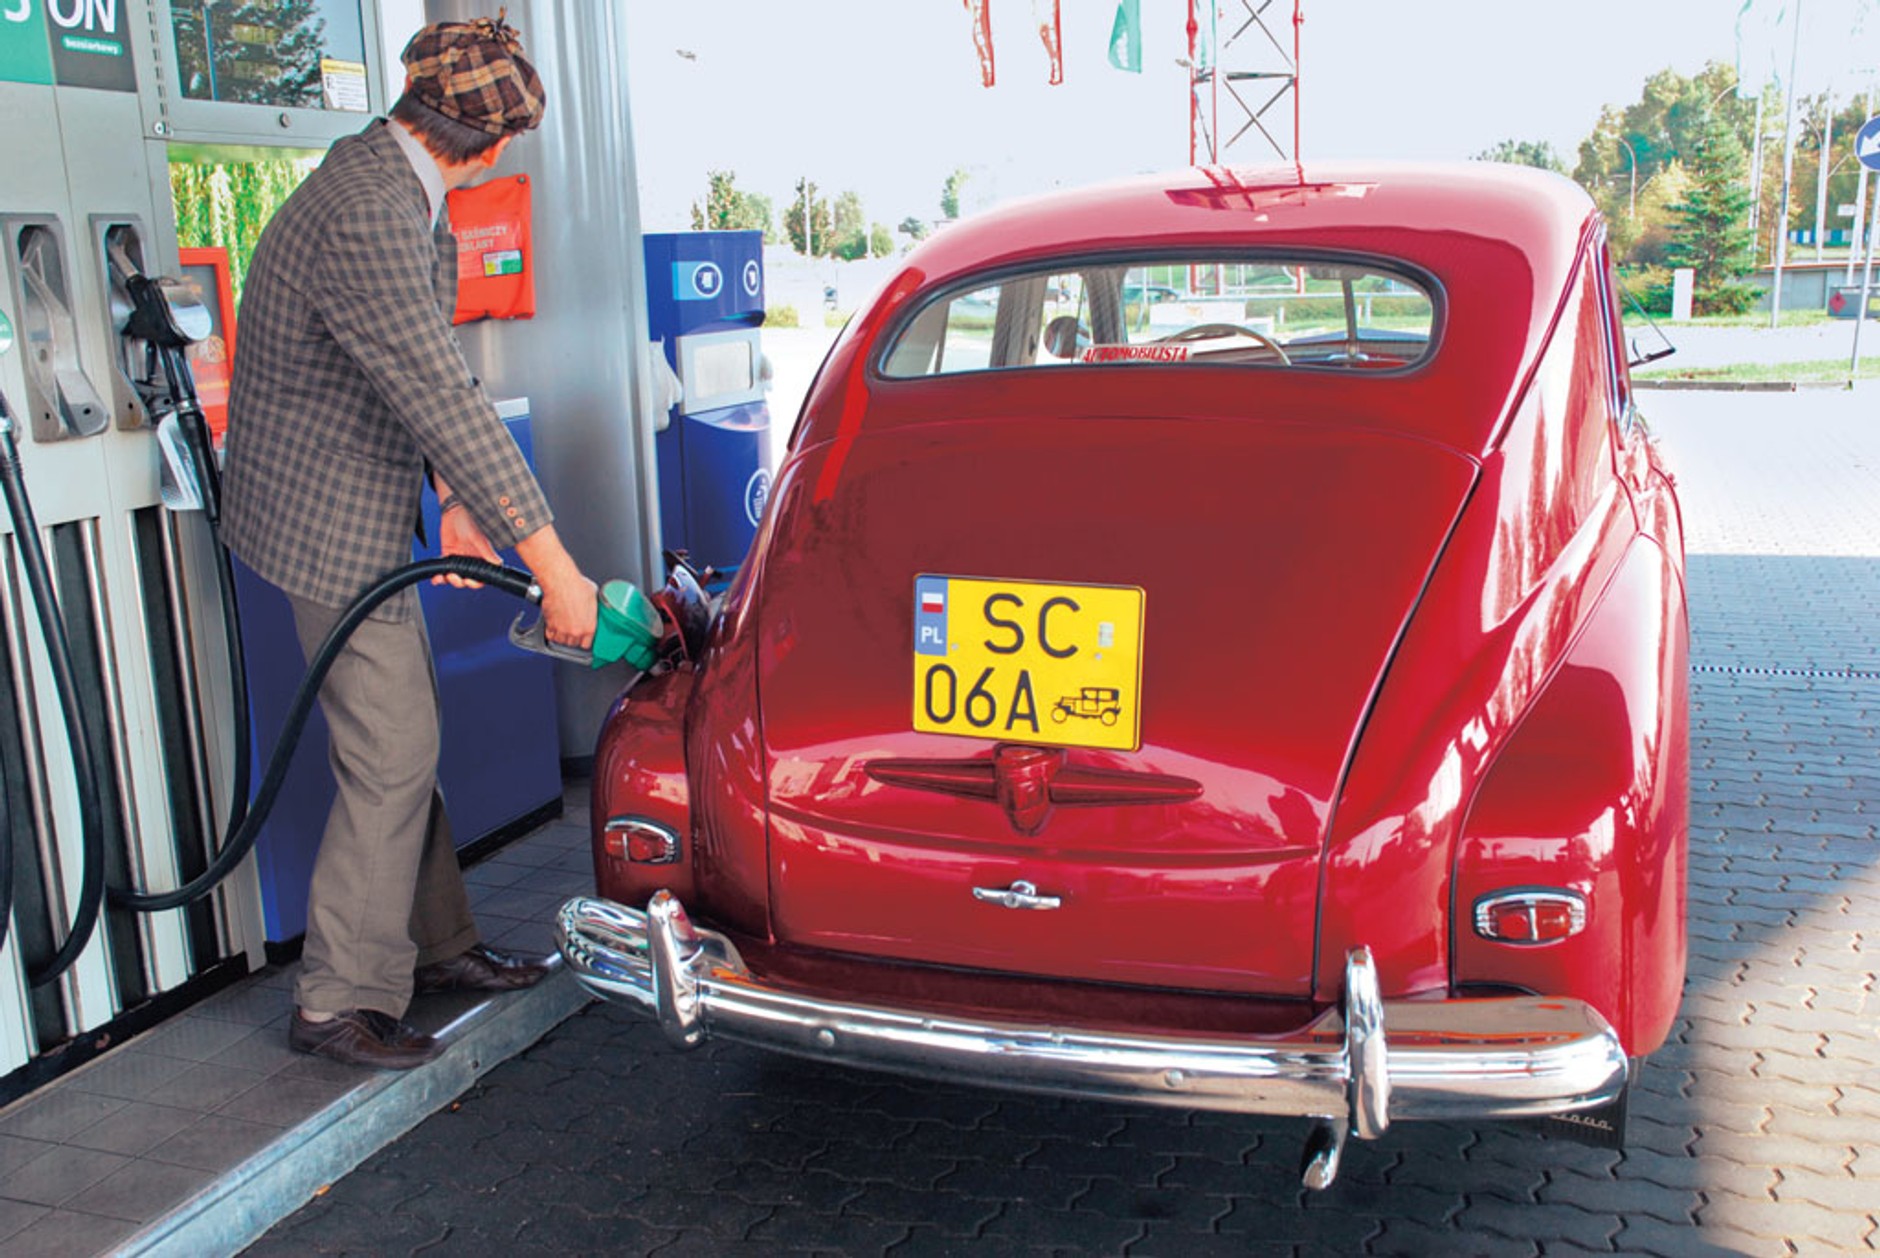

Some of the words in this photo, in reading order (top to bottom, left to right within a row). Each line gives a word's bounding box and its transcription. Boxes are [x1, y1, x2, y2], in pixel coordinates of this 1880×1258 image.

[1083, 346, 1188, 363] AUTOMOBILISTA
[920, 625, 944, 644] PL
[983, 592, 1081, 659] SC
[925, 663, 1040, 733] 06A
